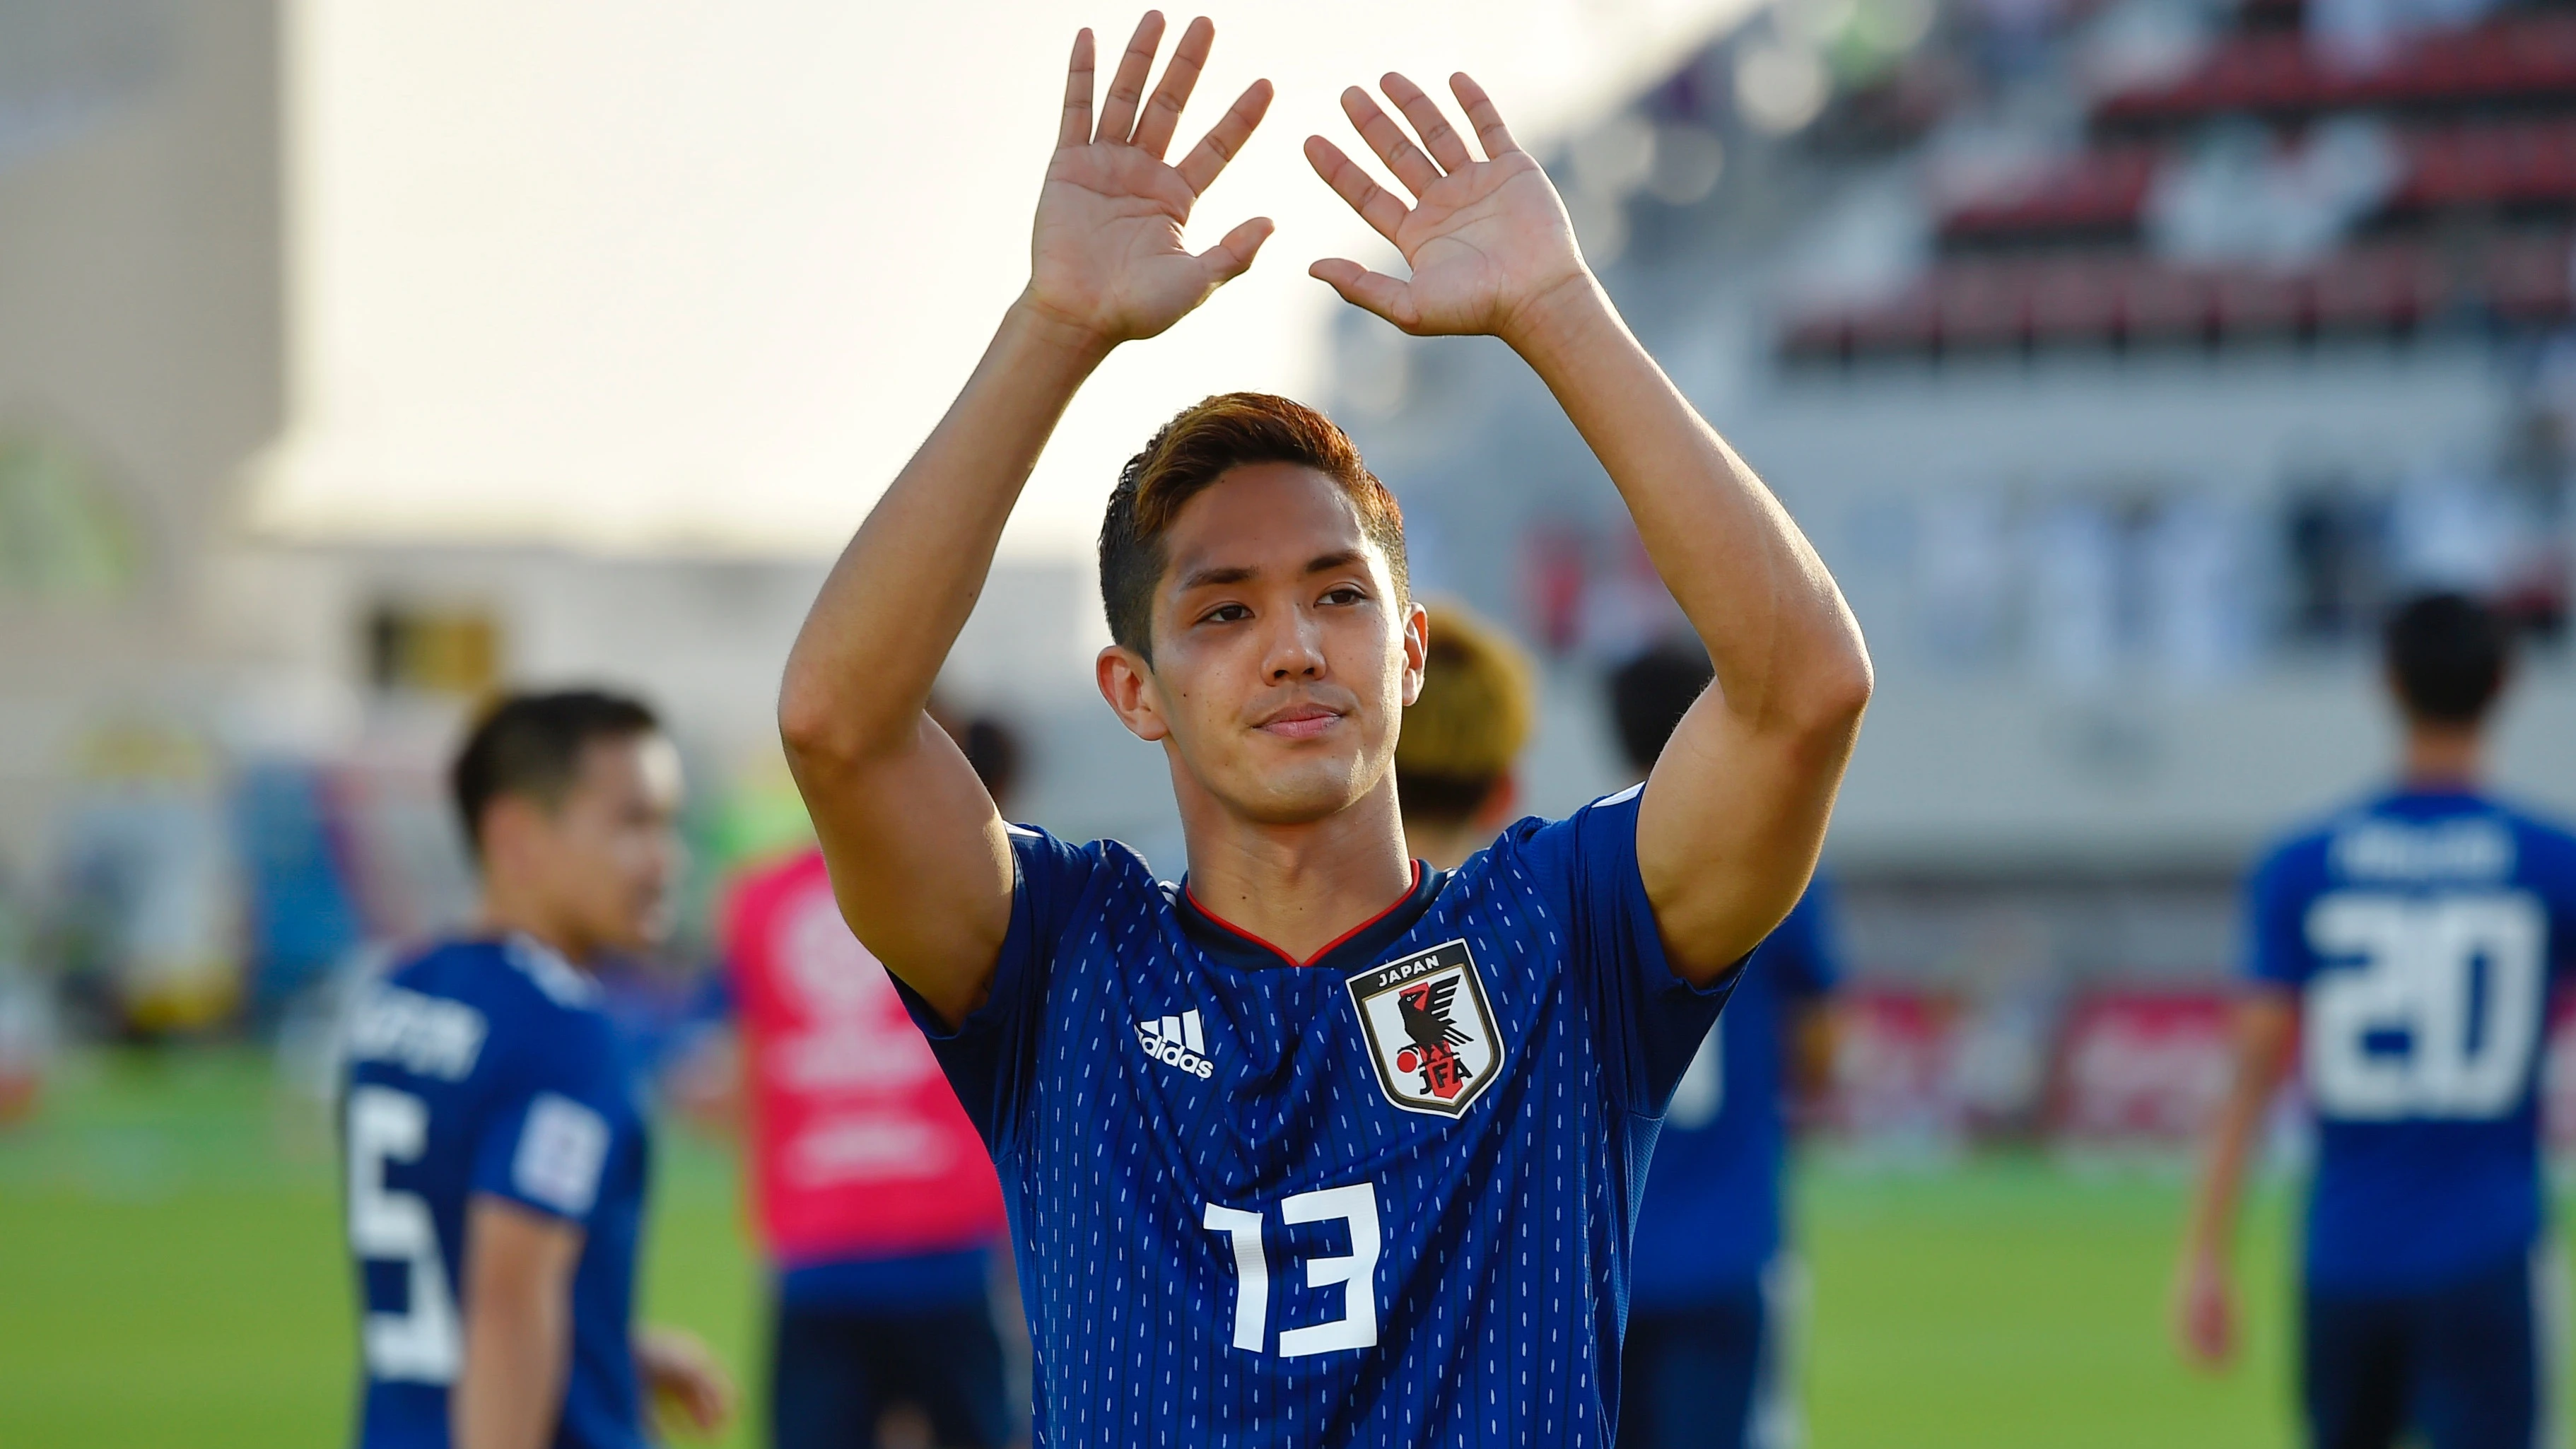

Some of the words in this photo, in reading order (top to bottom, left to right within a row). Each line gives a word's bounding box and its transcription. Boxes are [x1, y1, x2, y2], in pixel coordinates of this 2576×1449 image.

[1378, 954, 1440, 987] JAPAN
[1133, 1024, 1214, 1079] adidas
[1419, 1057, 1473, 1095] JFA
[349, 1084, 464, 1384] 5
[1203, 1182, 1381, 1357] 13
